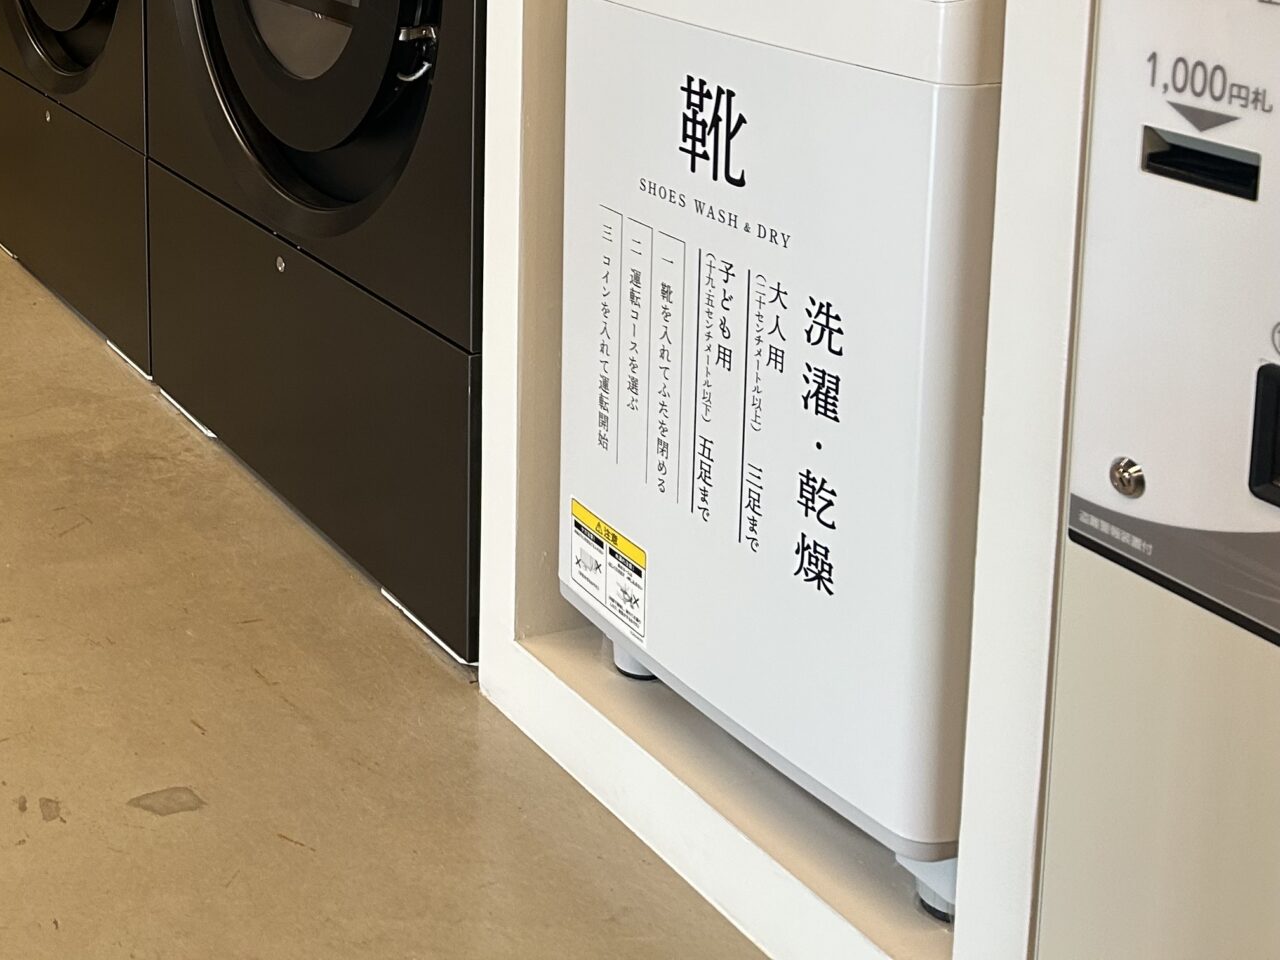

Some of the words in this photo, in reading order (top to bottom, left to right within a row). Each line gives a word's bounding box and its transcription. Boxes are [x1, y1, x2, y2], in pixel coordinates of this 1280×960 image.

[678, 74, 748, 188] 靴
[1146, 50, 1273, 114] 1,000円札
[639, 177, 687, 208] SHOES
[694, 198, 739, 229] WASH
[743, 221, 751, 233] &
[757, 223, 792, 249] DRY
[597, 255, 612, 452] コインを入れて運転開始
[626, 267, 642, 412] 運転コースを選ぶ
[715, 259, 736, 372] 子ども用
[765, 281, 788, 374] 大人用
[656, 281, 673, 494] 靴を入れてふたを閉める
[696, 434, 715, 523] 五足まで
[793, 295, 845, 597] 洗濯・乾燥
[603, 525, 619, 546] 注意
[744, 462, 764, 553] 三足まで
